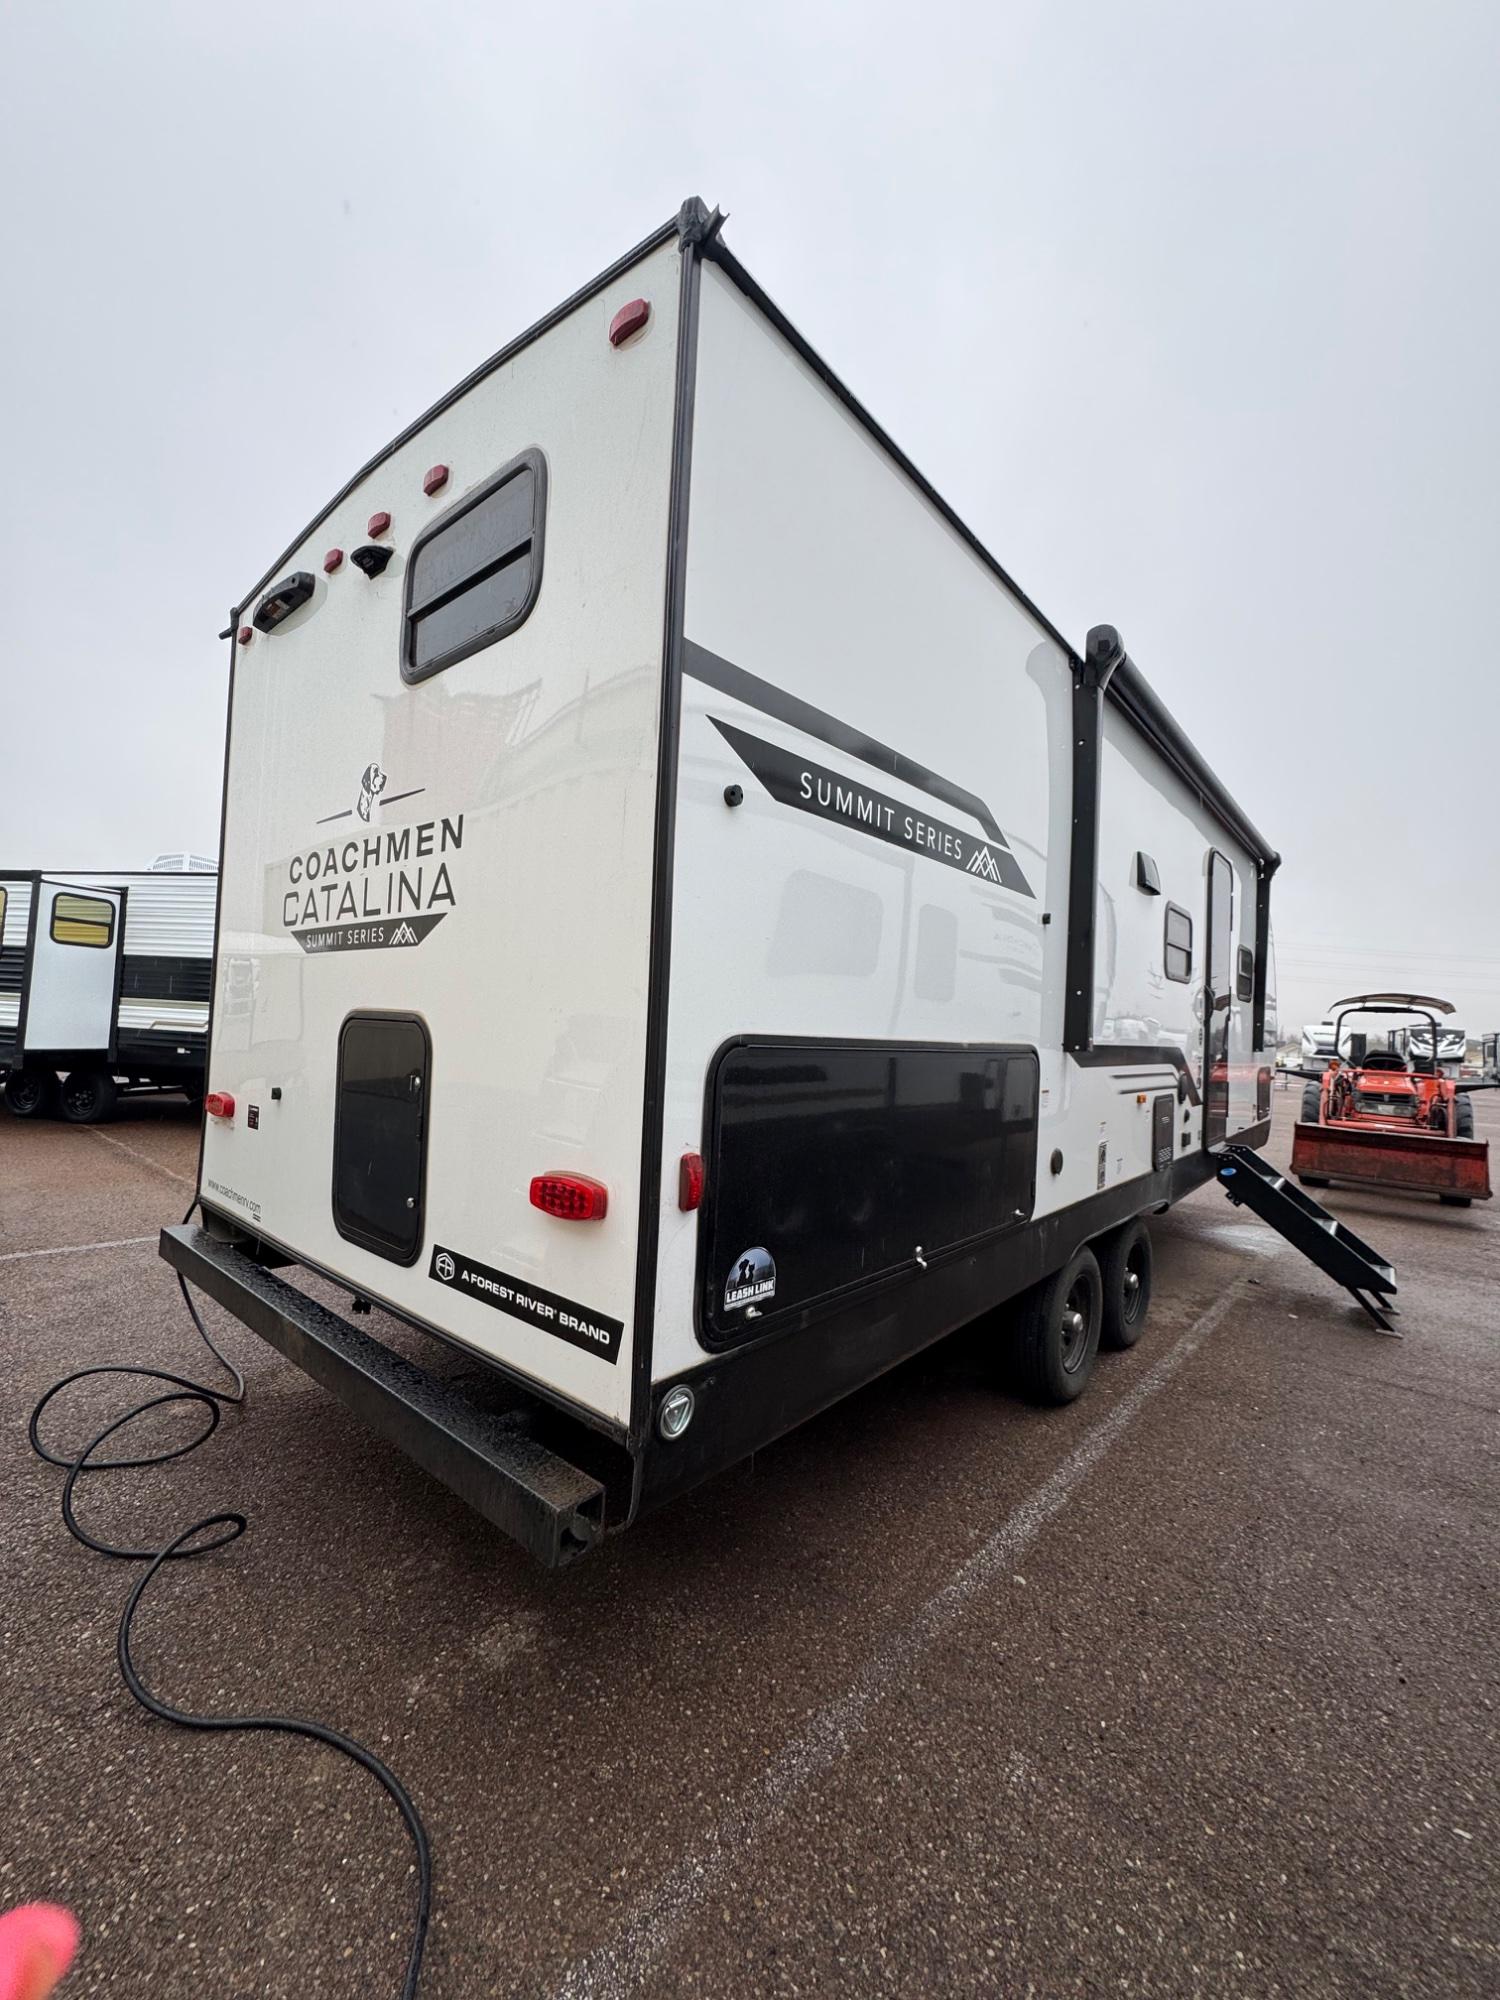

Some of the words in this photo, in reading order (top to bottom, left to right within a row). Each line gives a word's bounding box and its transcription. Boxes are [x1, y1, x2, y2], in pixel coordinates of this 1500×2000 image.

[289, 814, 464, 884] COACHMEN
[800, 771, 895, 831] SUMMIT
[904, 816, 962, 860] SERIES
[283, 862, 456, 927] CATALINA
[306, 931, 343, 949] SUMMIT
[347, 927, 385, 945] SERIES
[461, 1269, 470, 1283] A
[471, 1274, 515, 1301] FOREST
[559, 1311, 611, 1345] BRAND
[726, 1285, 754, 1303] LEASH
[755, 1279, 774, 1295] LINK
